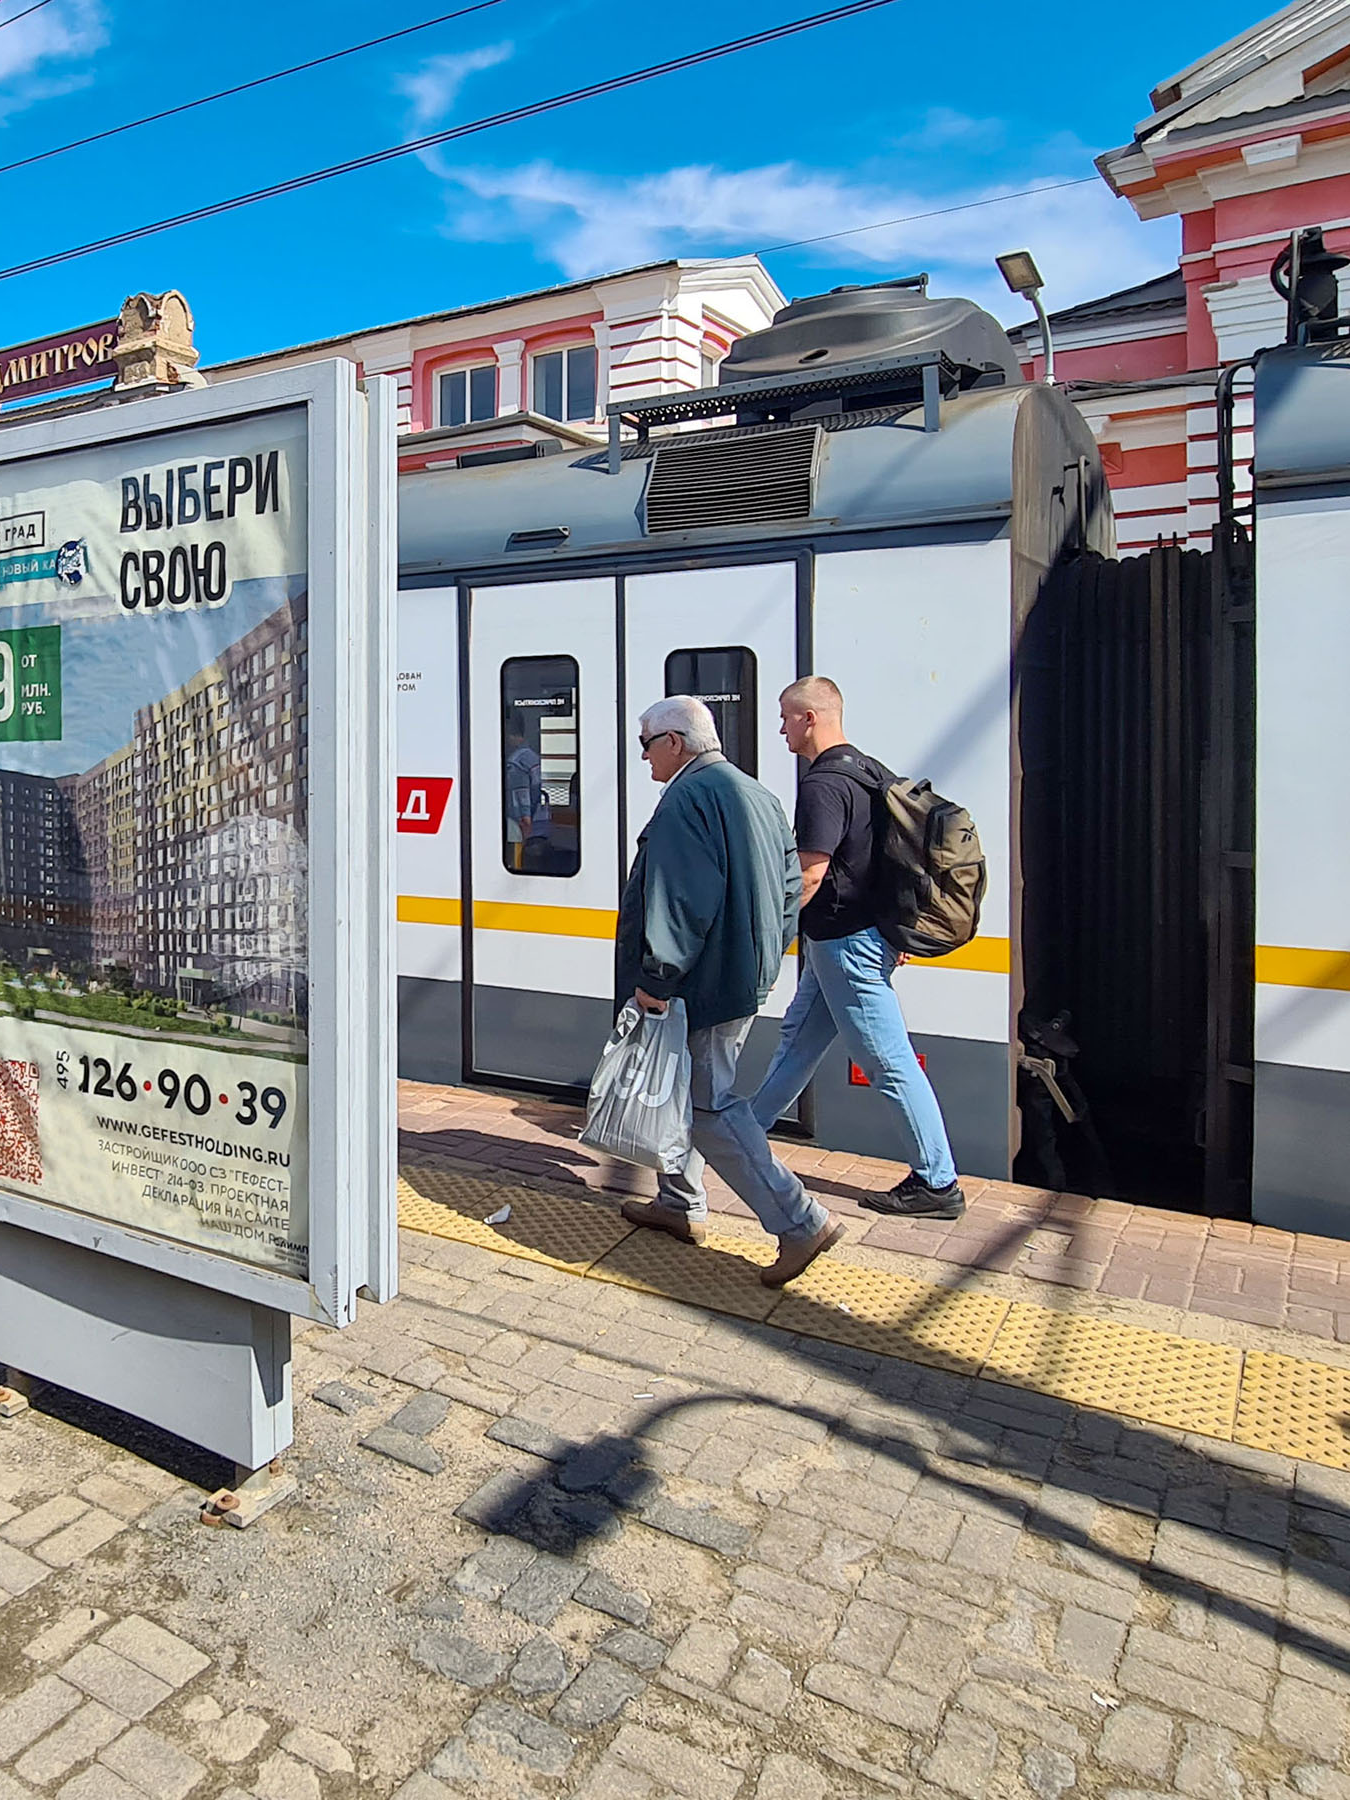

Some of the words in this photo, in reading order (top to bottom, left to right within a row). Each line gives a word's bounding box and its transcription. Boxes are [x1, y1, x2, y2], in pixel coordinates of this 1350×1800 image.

[120, 450, 279, 533] ВЫБЕРИ
[5, 523, 36, 541] ГРАД
[2, 560, 39, 577] НОВЫЙ
[120, 541, 226, 609] СВОЮ
[21, 701, 46, 716] РУБ.
[56, 1050, 70, 1090] 495
[97, 1114, 291, 1168] WWW.GEFESTHOLDING.RU
[98, 1139, 179, 1168] ЗАСТРОЙЩИК
[180, 1158, 207, 1176] ООО
[210, 1166, 227, 1180] СЗ
[142, 1184, 221, 1216] ДЕКЛАРАЦИЯ
[225, 1205, 243, 1220] НА
[244, 1209, 290, 1231] САЙТЕ
[211, 1183, 289, 1213] ПРОЕКТНАЯ
